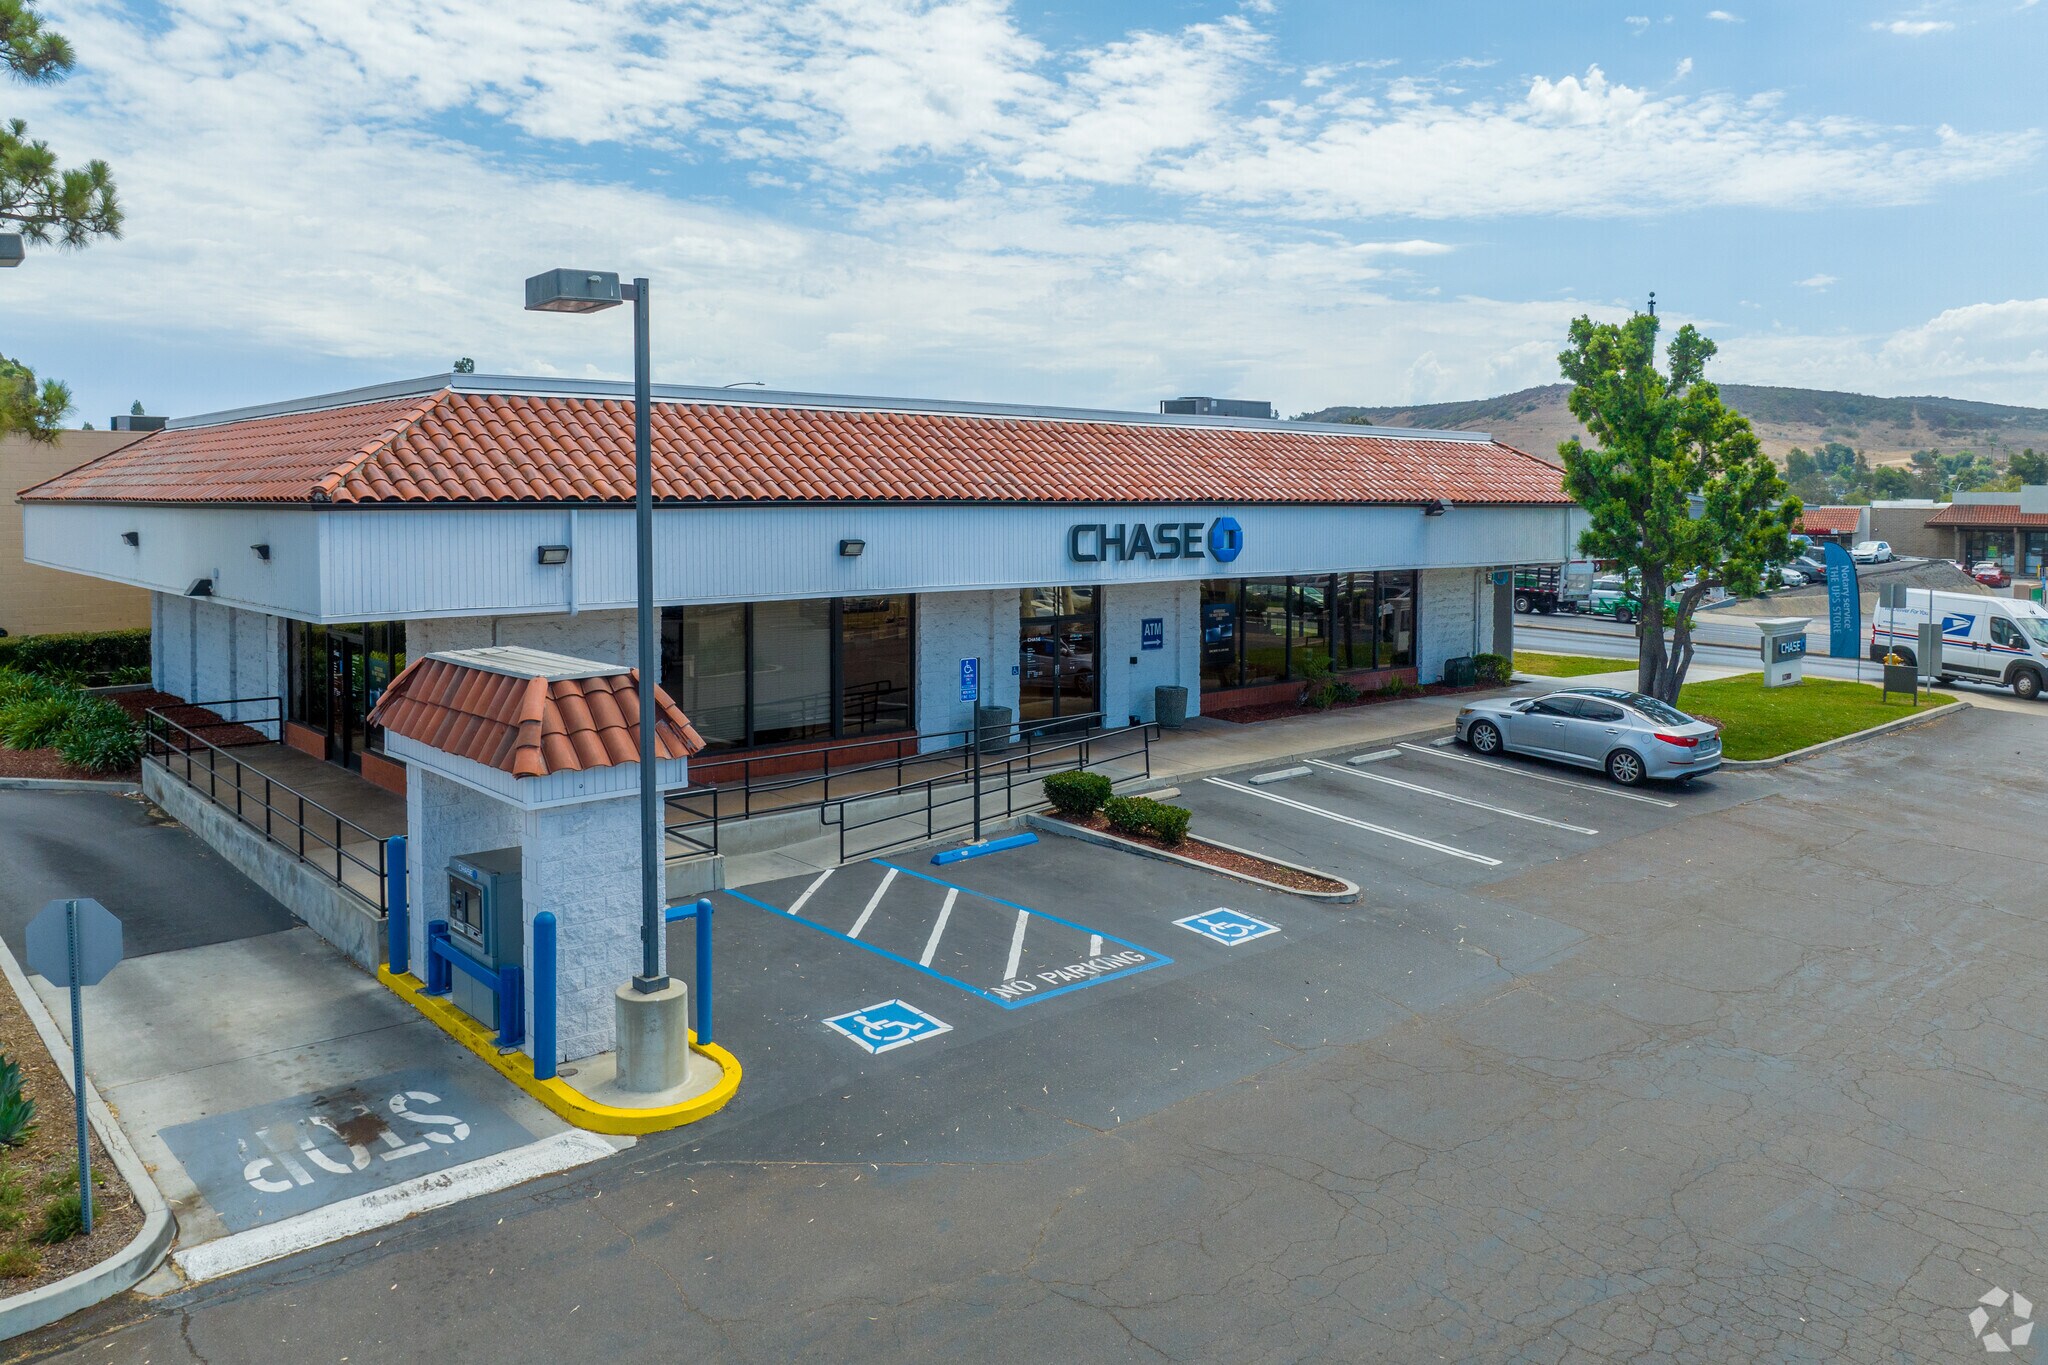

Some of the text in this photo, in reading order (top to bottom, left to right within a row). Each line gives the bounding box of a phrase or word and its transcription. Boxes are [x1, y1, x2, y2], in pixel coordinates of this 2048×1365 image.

[1067, 523, 1205, 562] CHASE
[1830, 565, 1842, 634] THE UPS STORE
[1841, 565, 1853, 629] Notary service
[1144, 622, 1162, 636] ATM
[1781, 640, 1801, 654] CHASE
[458, 865, 474, 877] CHASE
[990, 951, 1146, 998] NO PARKING
[242, 1090, 471, 1193] STOP
